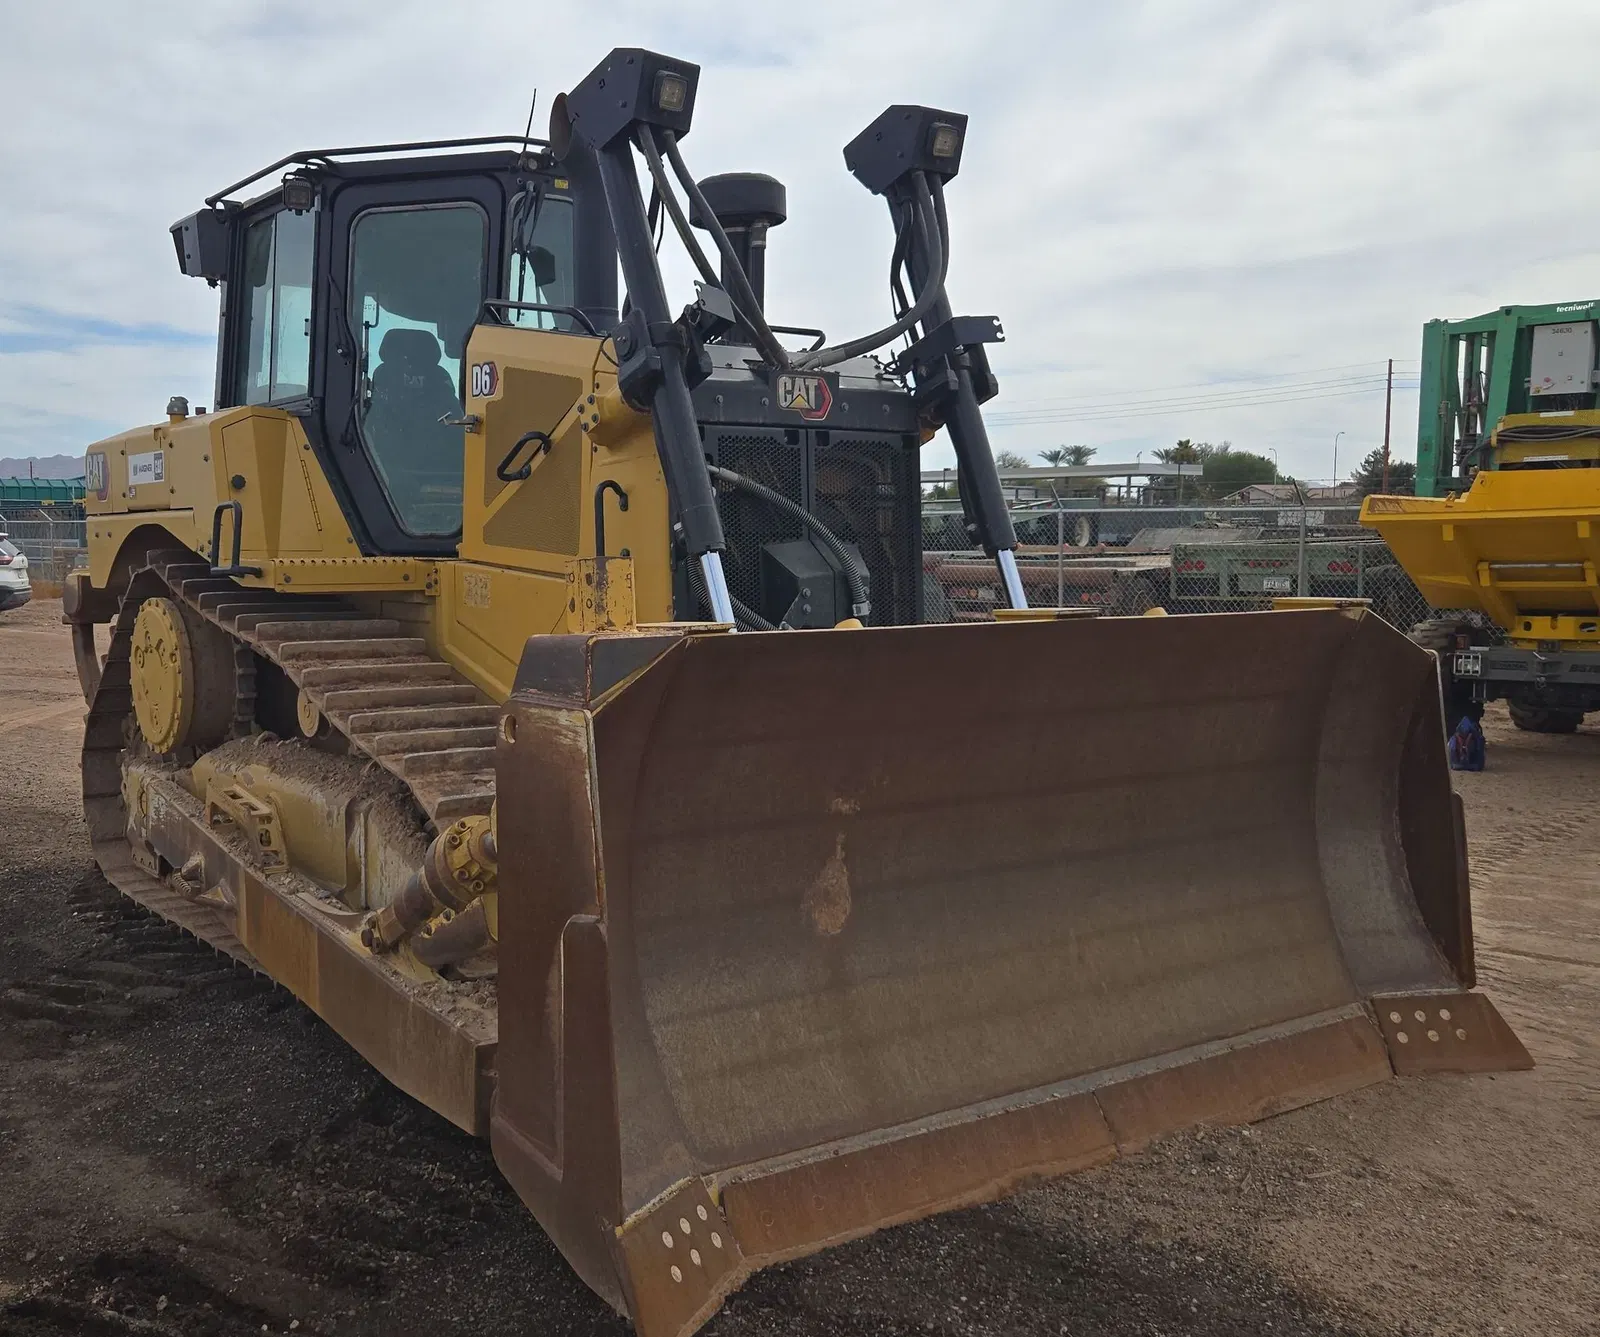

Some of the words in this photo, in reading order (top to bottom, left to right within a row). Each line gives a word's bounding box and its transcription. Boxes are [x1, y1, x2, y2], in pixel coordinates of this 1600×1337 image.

[472, 364, 490, 396] D6
[778, 376, 818, 409] CAT
[87, 453, 104, 490] CAT
